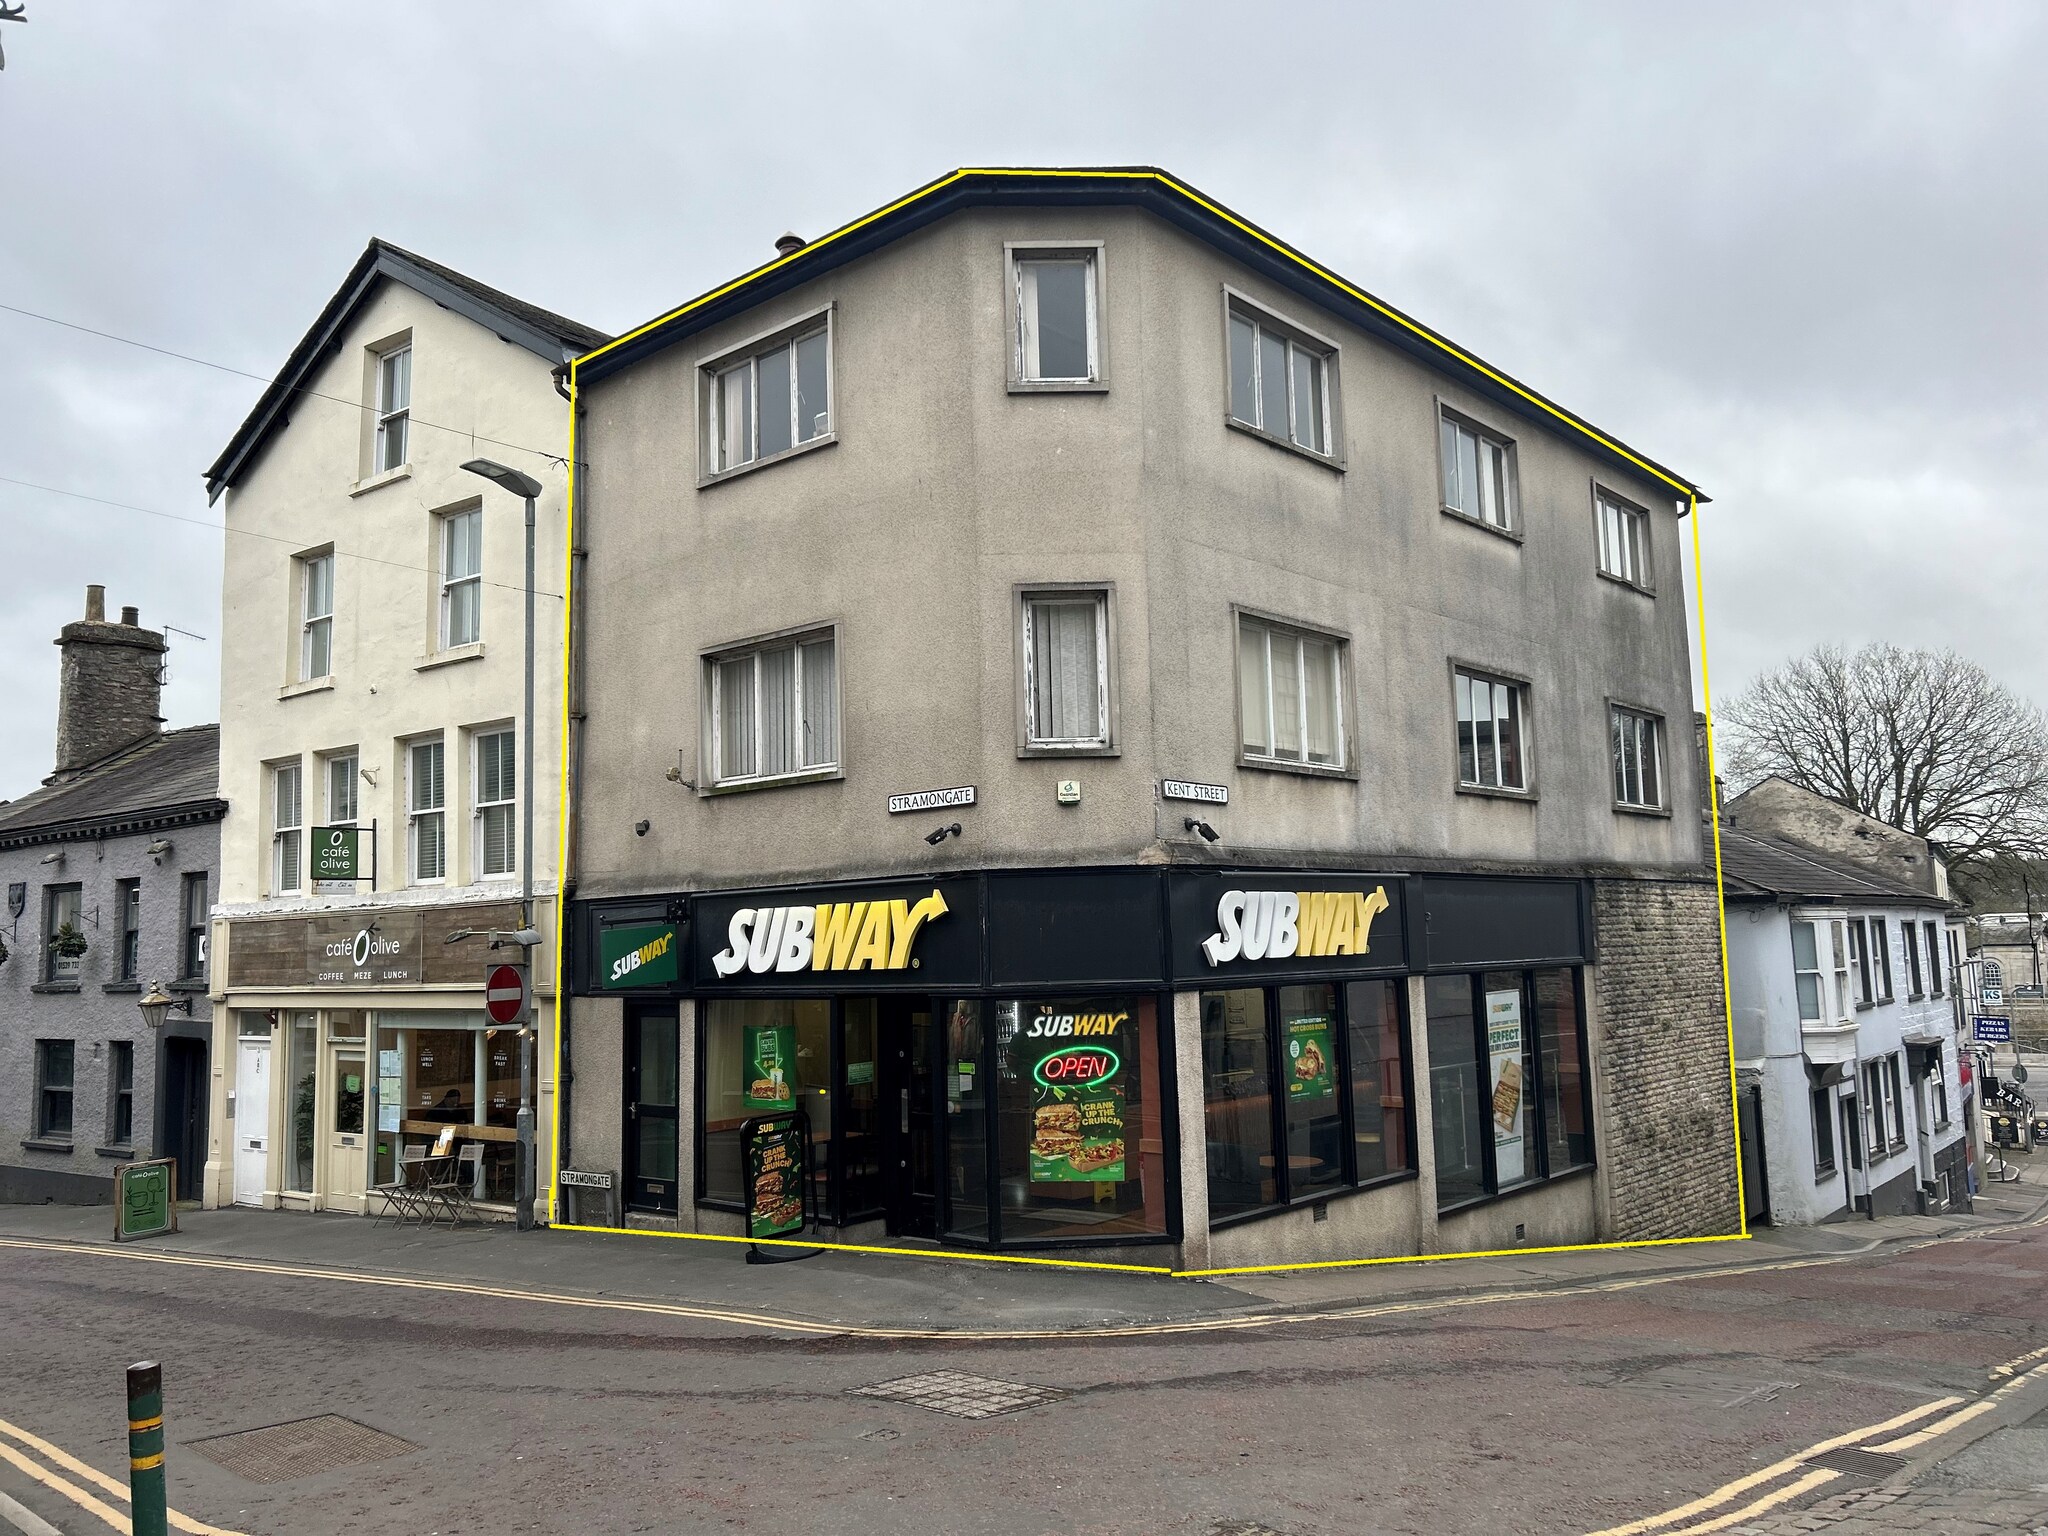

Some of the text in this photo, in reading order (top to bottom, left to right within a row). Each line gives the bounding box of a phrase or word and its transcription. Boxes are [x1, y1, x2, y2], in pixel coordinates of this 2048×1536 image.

[1167, 782, 1225, 800] KENT STREET
[891, 789, 971, 810] STRAMONGATE
[321, 846, 350, 857] café
[320, 857, 351, 869] olive
[711, 888, 949, 979] SUBWAY
[1201, 885, 1390, 968] SUBWAY
[326, 935, 400, 957] café olive
[610, 931, 673, 981] SUBWAY
[318, 970, 408, 981] COFFEE MEZE LUNCH
[1984, 990, 2001, 1000] KS
[1026, 1010, 1129, 1038] SUBWAY
[1489, 1028, 1519, 1044] PERFECT
[1045, 1057, 1107, 1078] OPEN
[1996, 1088, 2022, 1107] BAR
[1084, 1101, 1115, 1111] CRANK
[1085, 1108, 1115, 1118] UP THE
[757, 1120, 793, 1134] SUBWAY
[1081, 1116, 1123, 1128] CRUNCH
[762, 1145, 786, 1157] CRANK
[764, 1152, 787, 1165] UP THE
[761, 1158, 793, 1173] CRUNCH
[561, 1172, 610, 1187] STRAMONGATE
